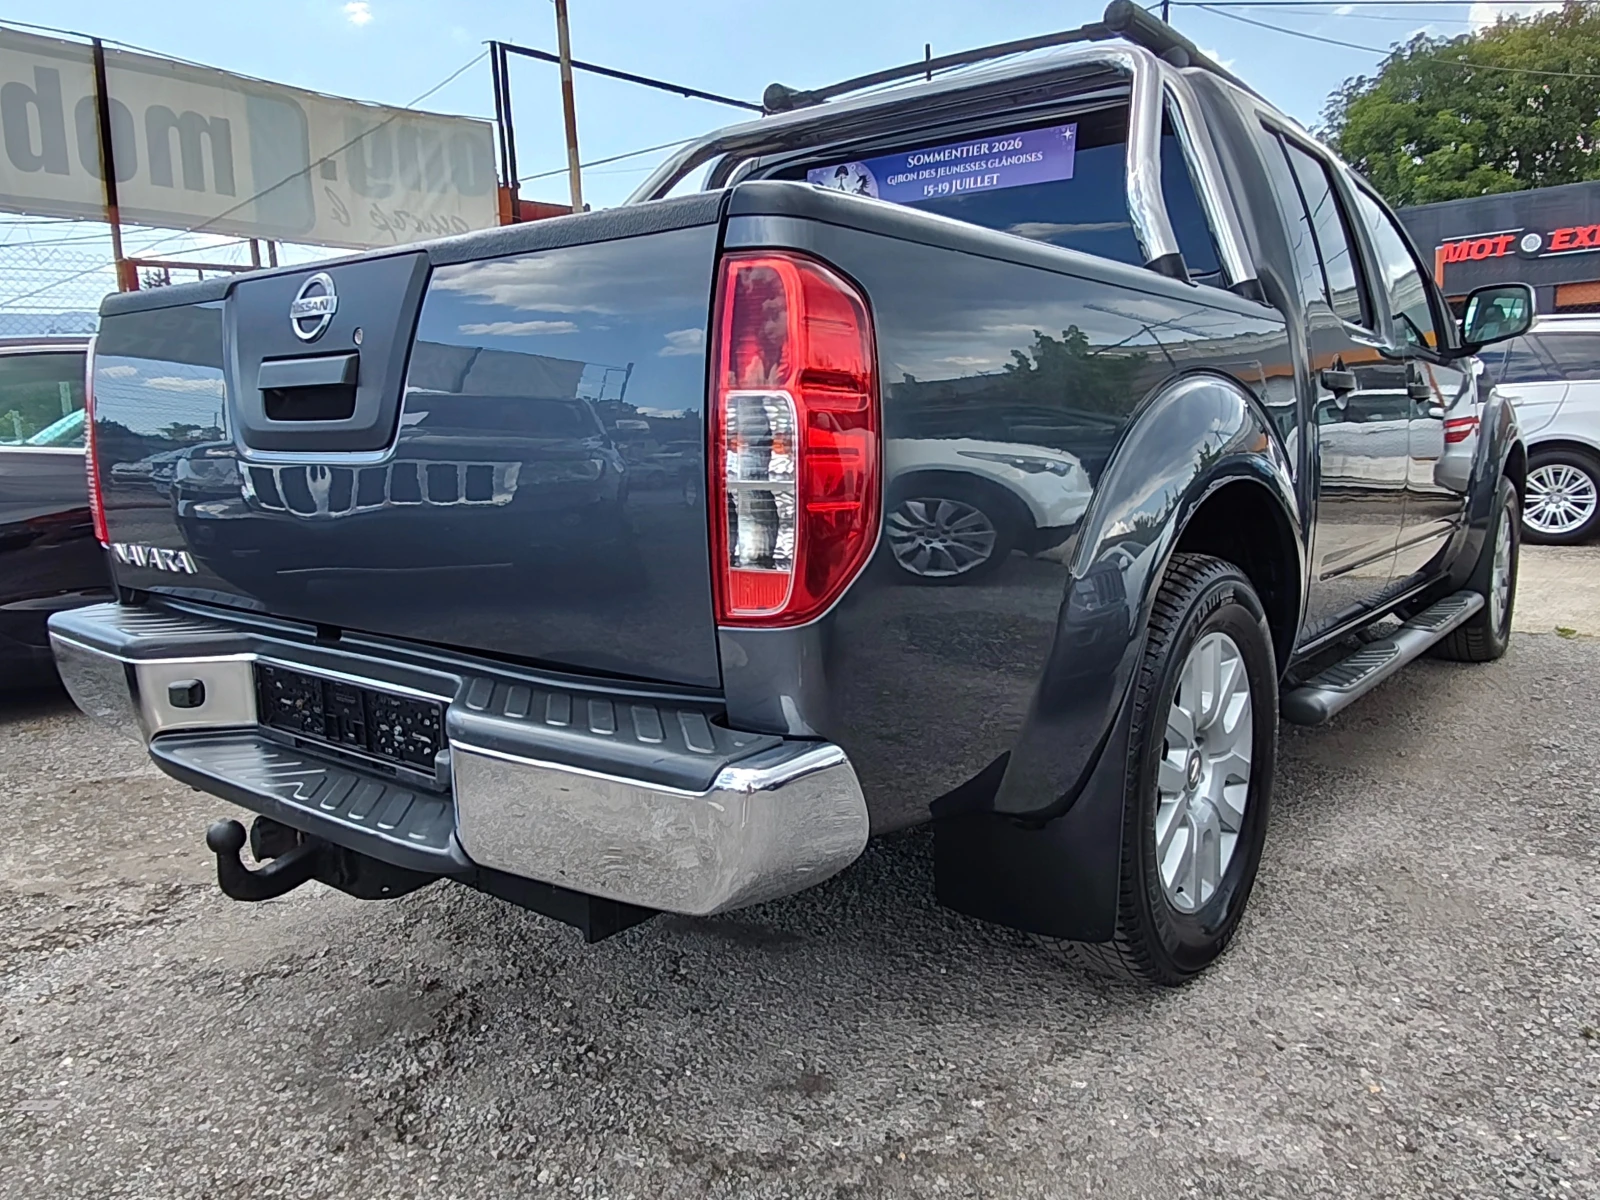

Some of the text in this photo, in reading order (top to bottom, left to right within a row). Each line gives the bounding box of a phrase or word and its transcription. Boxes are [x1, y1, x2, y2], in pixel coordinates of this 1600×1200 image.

[887, 151, 1043, 185] GIRON DES JEUNESSES GLÂNOISES
[907, 137, 1023, 168] SOMMENTIER 2026
[923, 173, 1000, 197] 15-19 JUILLET
[292, 299, 329, 313] NISSAN
[111, 543, 198, 574] NAVARA
